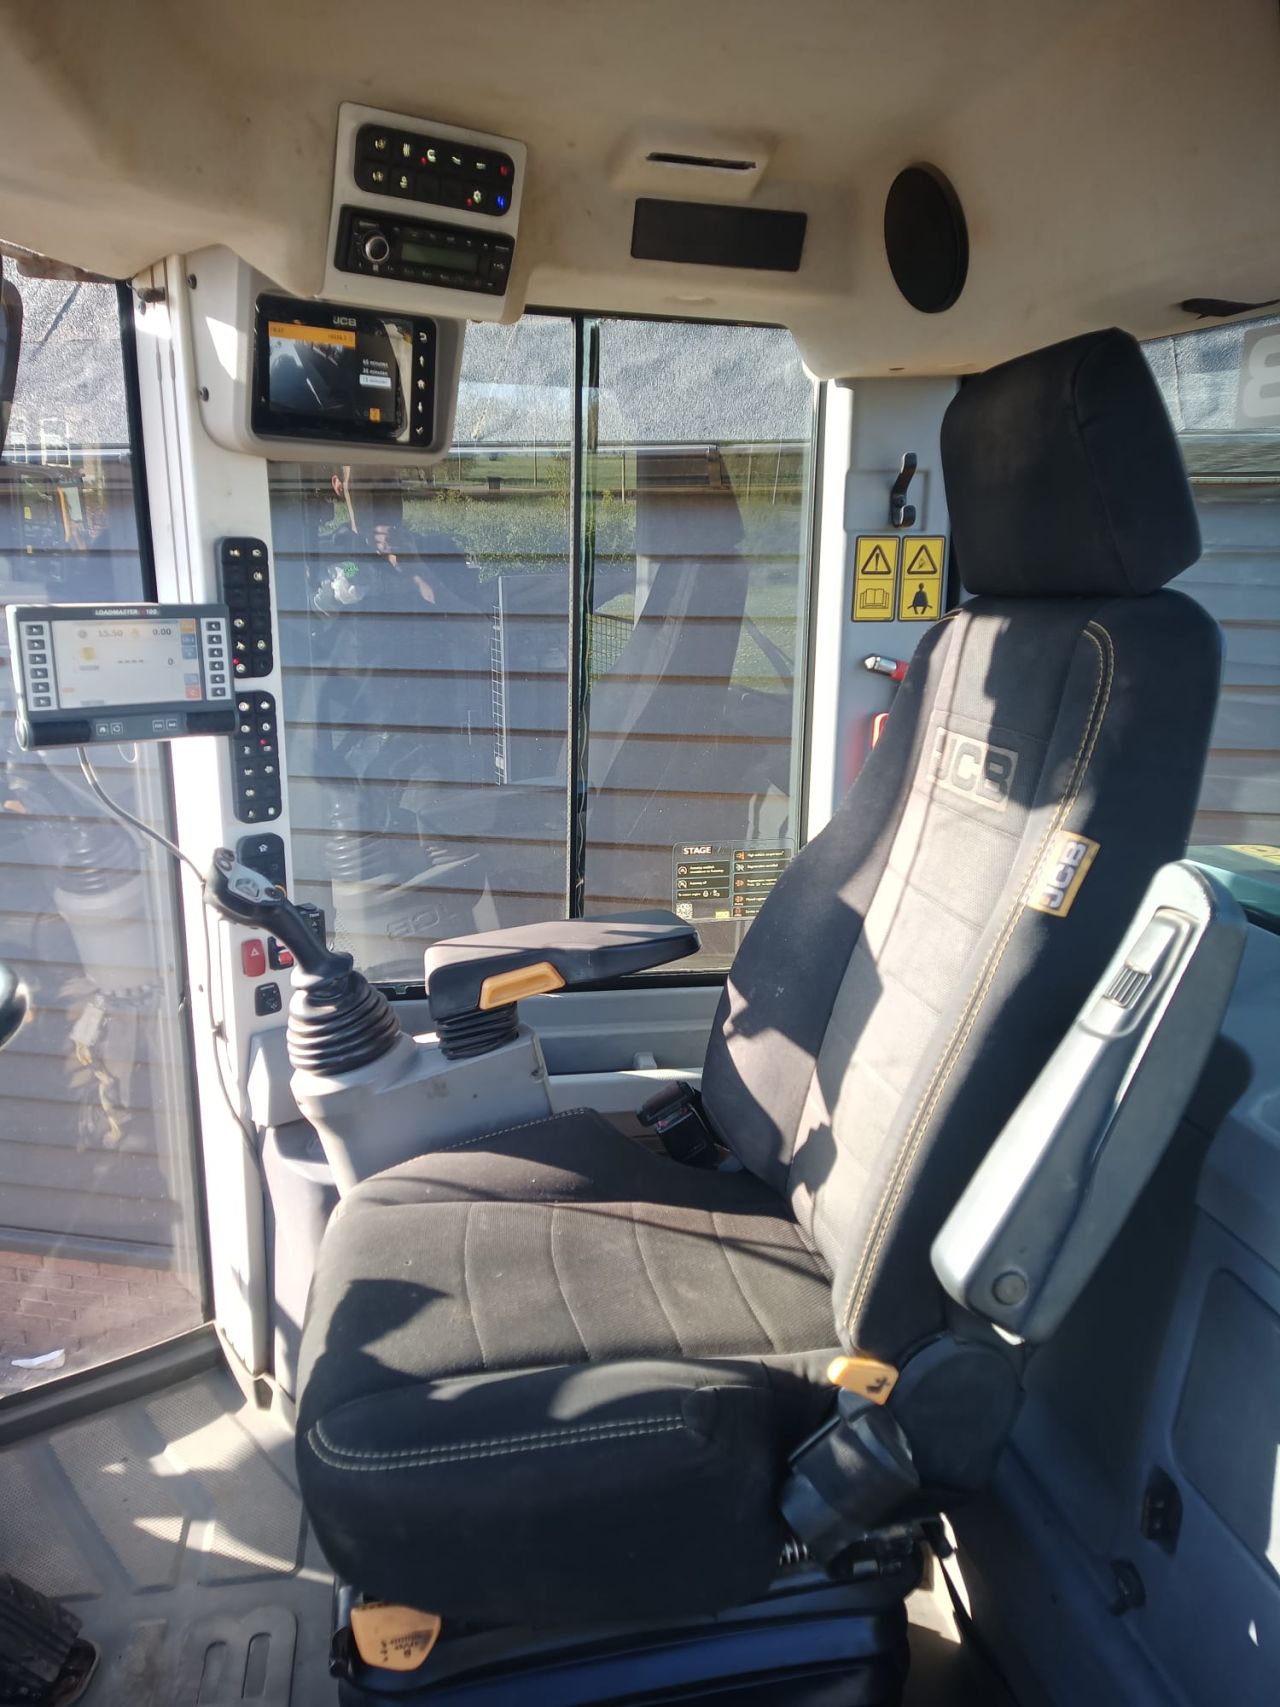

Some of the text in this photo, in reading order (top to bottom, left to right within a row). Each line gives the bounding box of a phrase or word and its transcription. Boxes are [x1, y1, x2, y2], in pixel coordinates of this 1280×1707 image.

[332, 316, 357, 327] JCB
[95, 608, 138, 616] LOADMASTER
[932, 732, 1015, 806] JCB
[683, 846, 712, 855] STAGE
[1040, 841, 1088, 909] JCB
